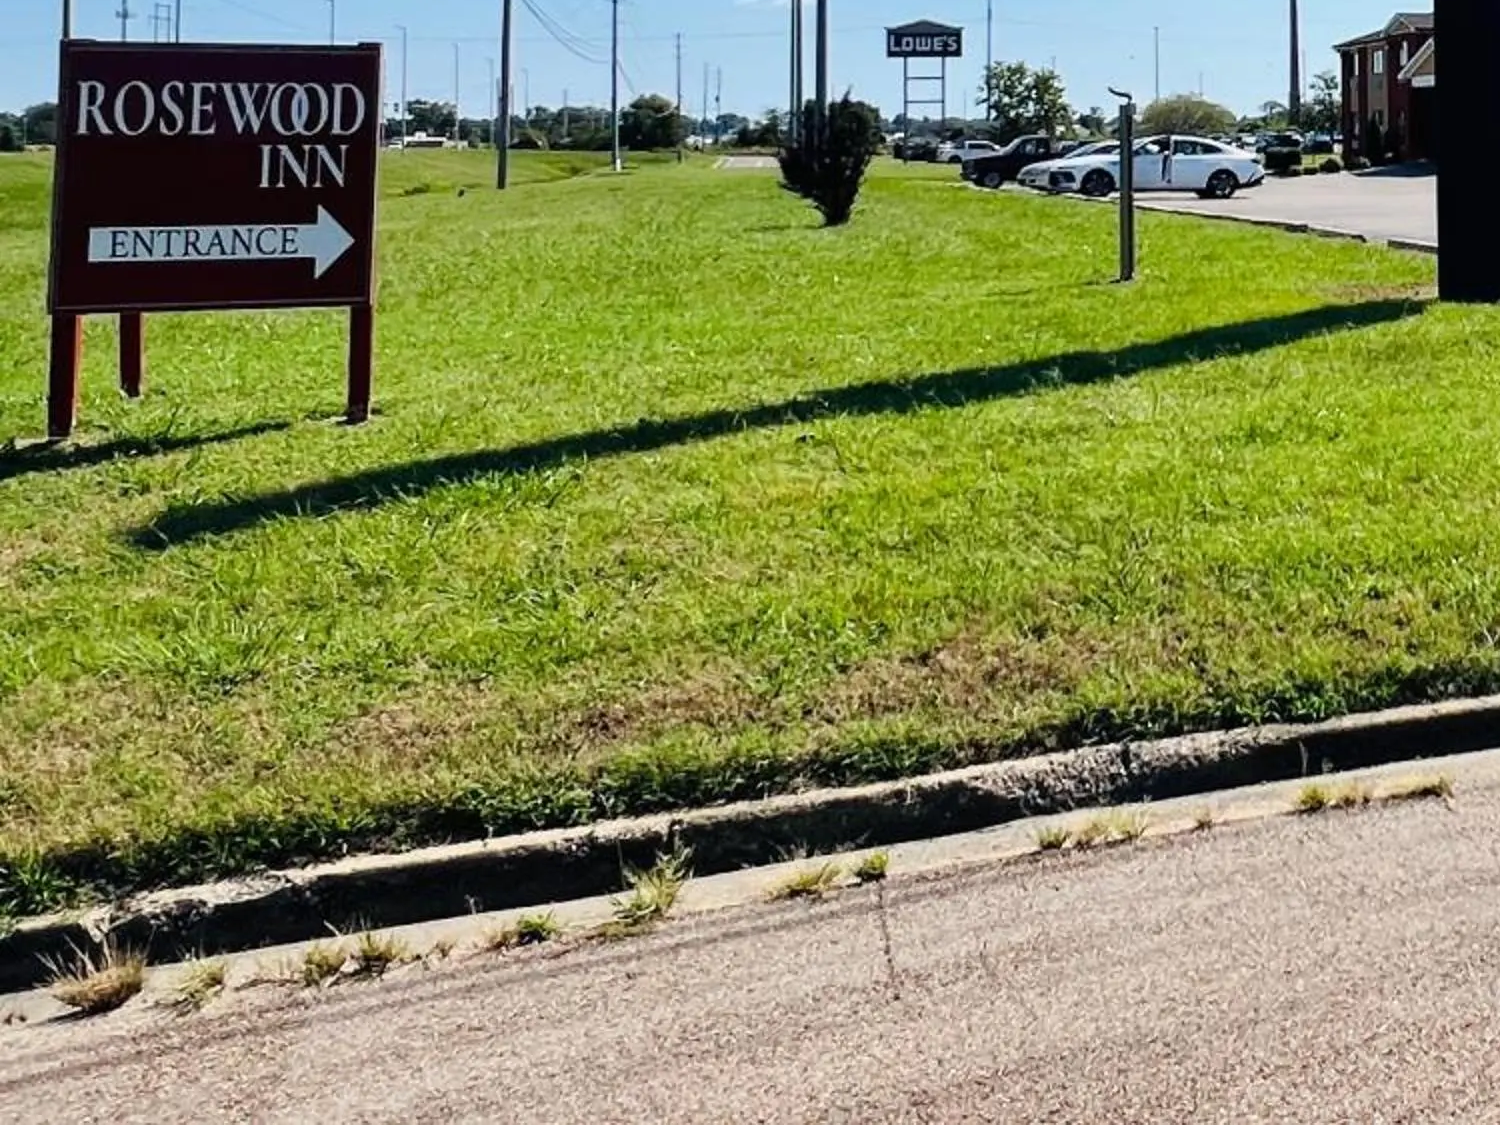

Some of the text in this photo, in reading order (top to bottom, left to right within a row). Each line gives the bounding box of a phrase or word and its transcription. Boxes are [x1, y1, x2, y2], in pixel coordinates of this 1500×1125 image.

[890, 35, 957, 50] LOWE'S
[77, 81, 364, 135] ROSEWOOD
[259, 145, 346, 186] INN
[109, 227, 298, 257] ENTRANCE
